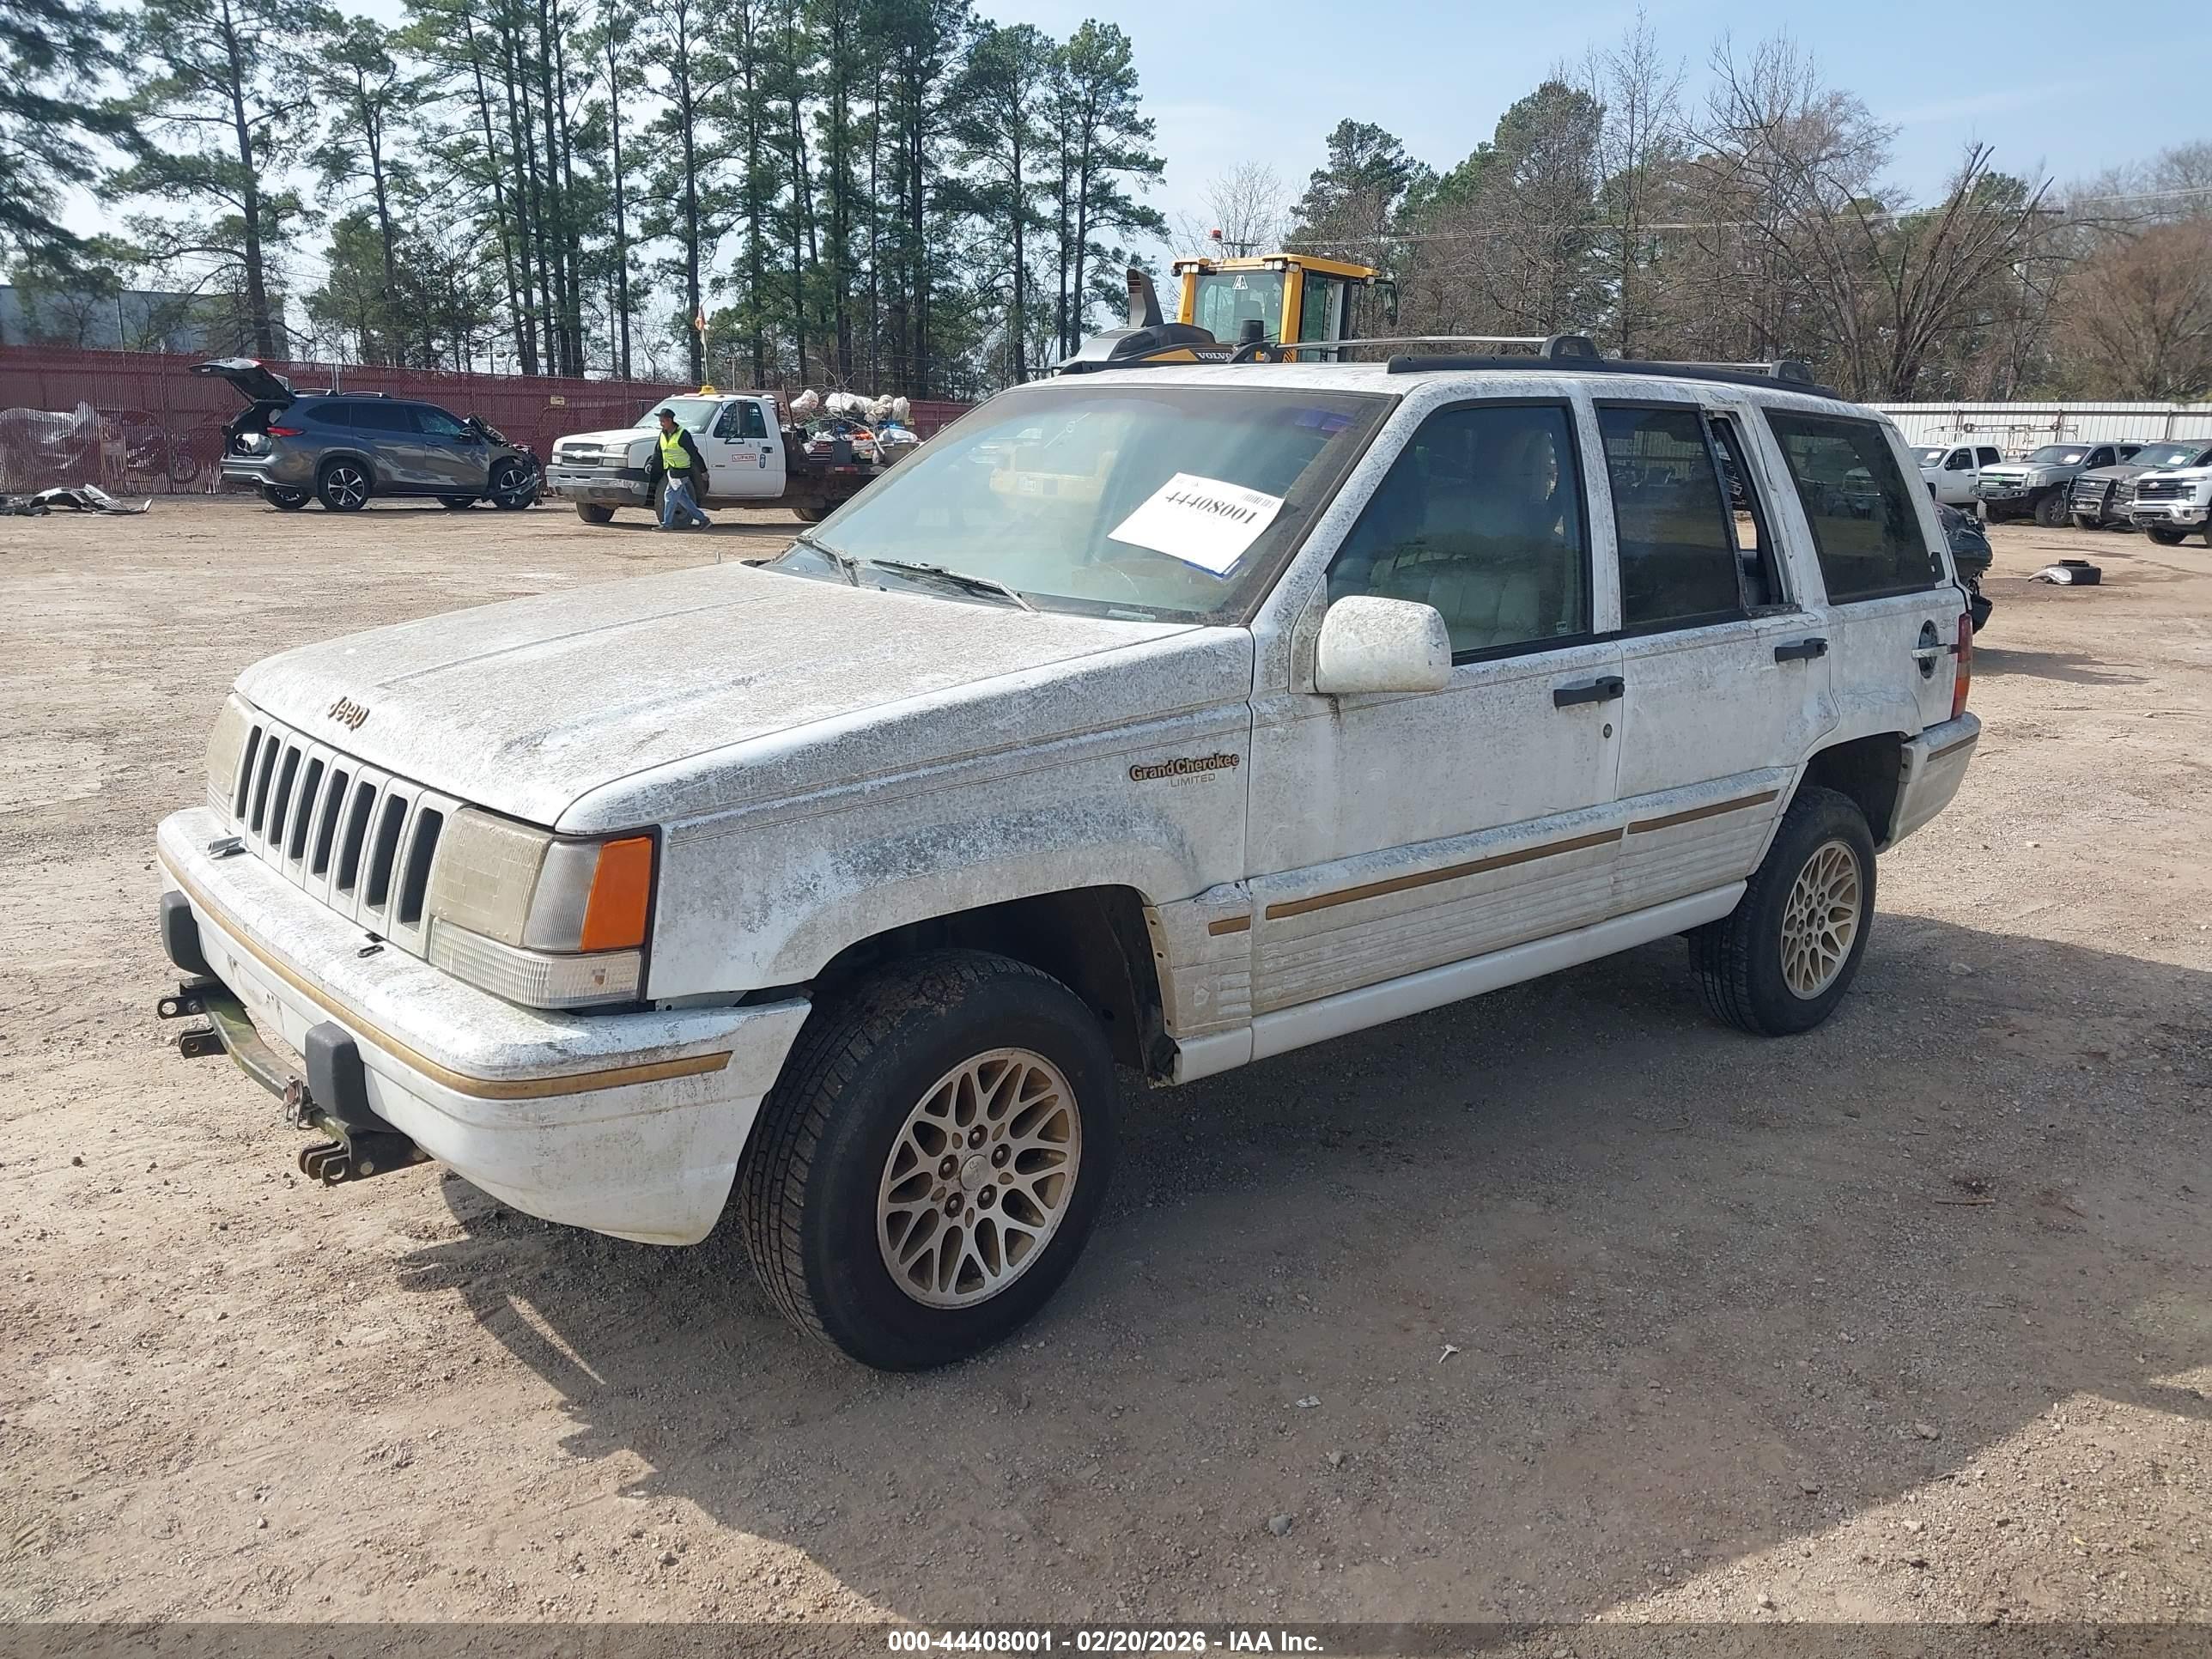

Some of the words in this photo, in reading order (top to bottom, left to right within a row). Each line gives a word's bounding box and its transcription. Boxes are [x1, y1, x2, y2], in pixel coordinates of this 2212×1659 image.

[1165, 491, 1258, 524] 44408001
[327, 696, 370, 733] Jeep
[1170, 773, 1216, 787] LIMITED
